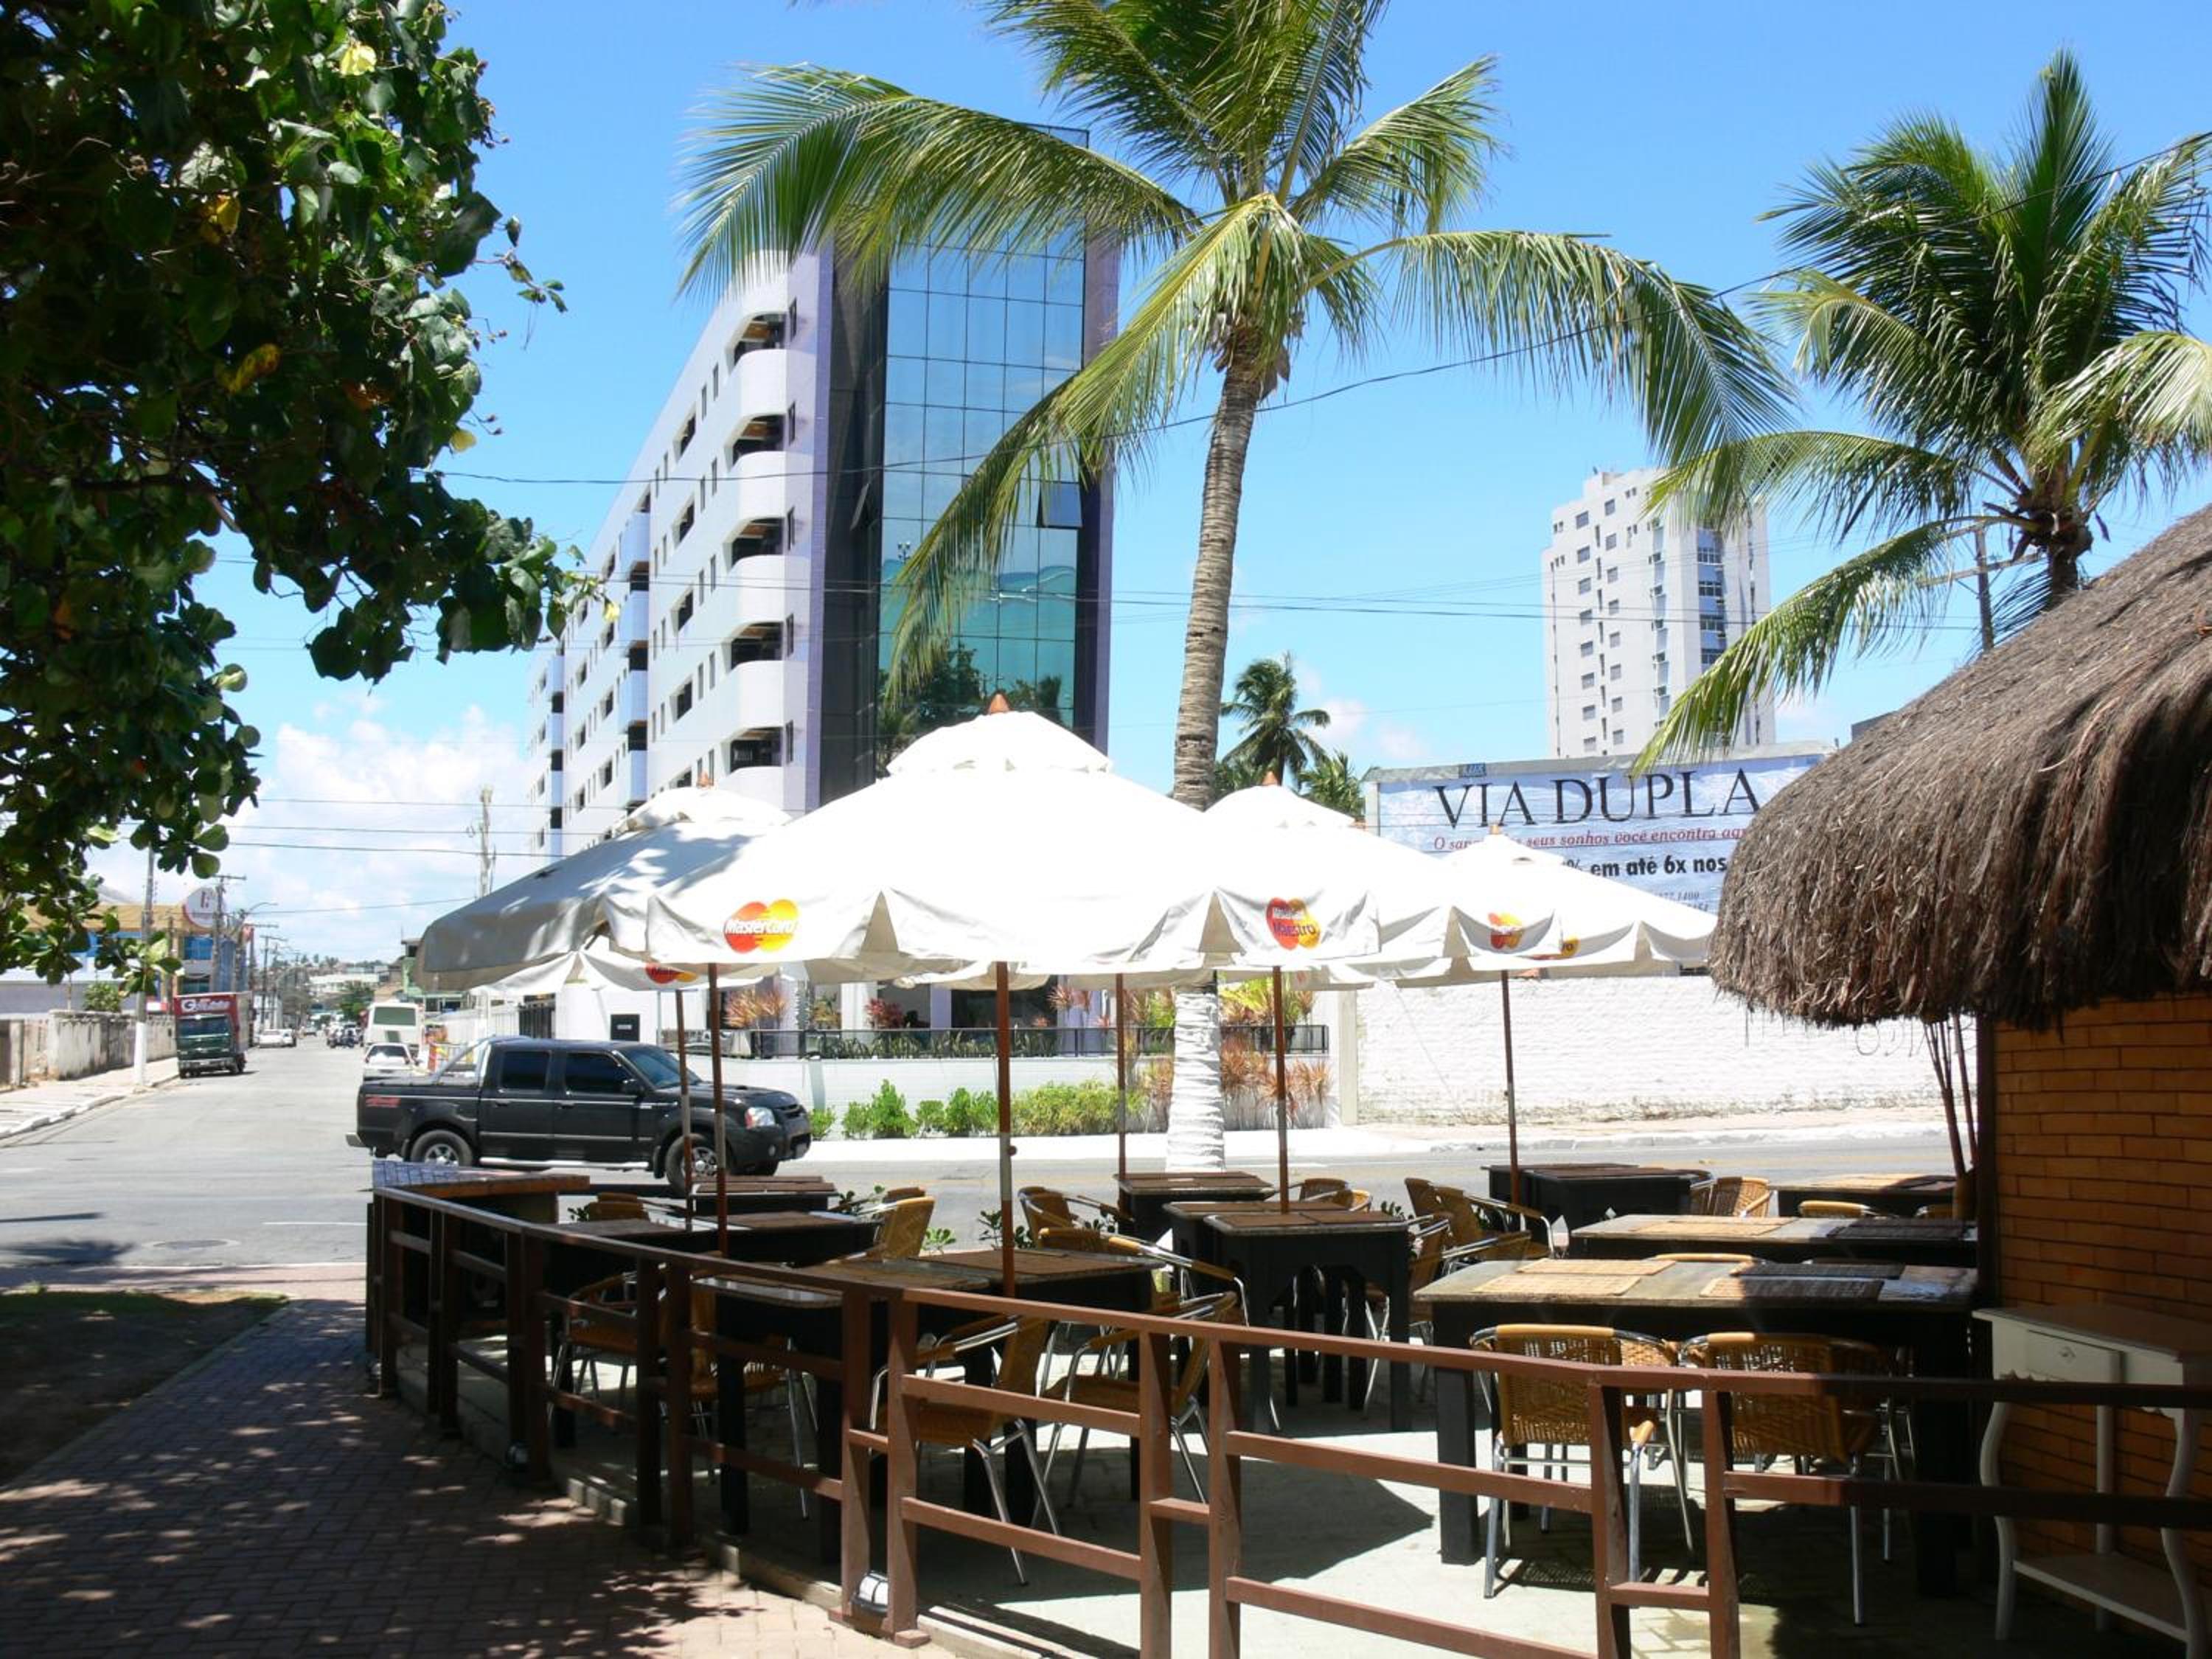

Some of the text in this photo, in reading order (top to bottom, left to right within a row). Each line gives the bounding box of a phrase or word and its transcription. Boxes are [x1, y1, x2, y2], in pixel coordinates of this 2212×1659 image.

[1432, 768, 1761, 829] VIA DUPLA
[1434, 836, 1445, 849] O
[1560, 830, 1609, 846] sonhos
[1651, 827, 1717, 841] encontra
[1590, 862, 1620, 877] em
[1626, 855, 1658, 876] até
[1663, 855, 1687, 874] 6x
[1693, 857, 1728, 872] nos
